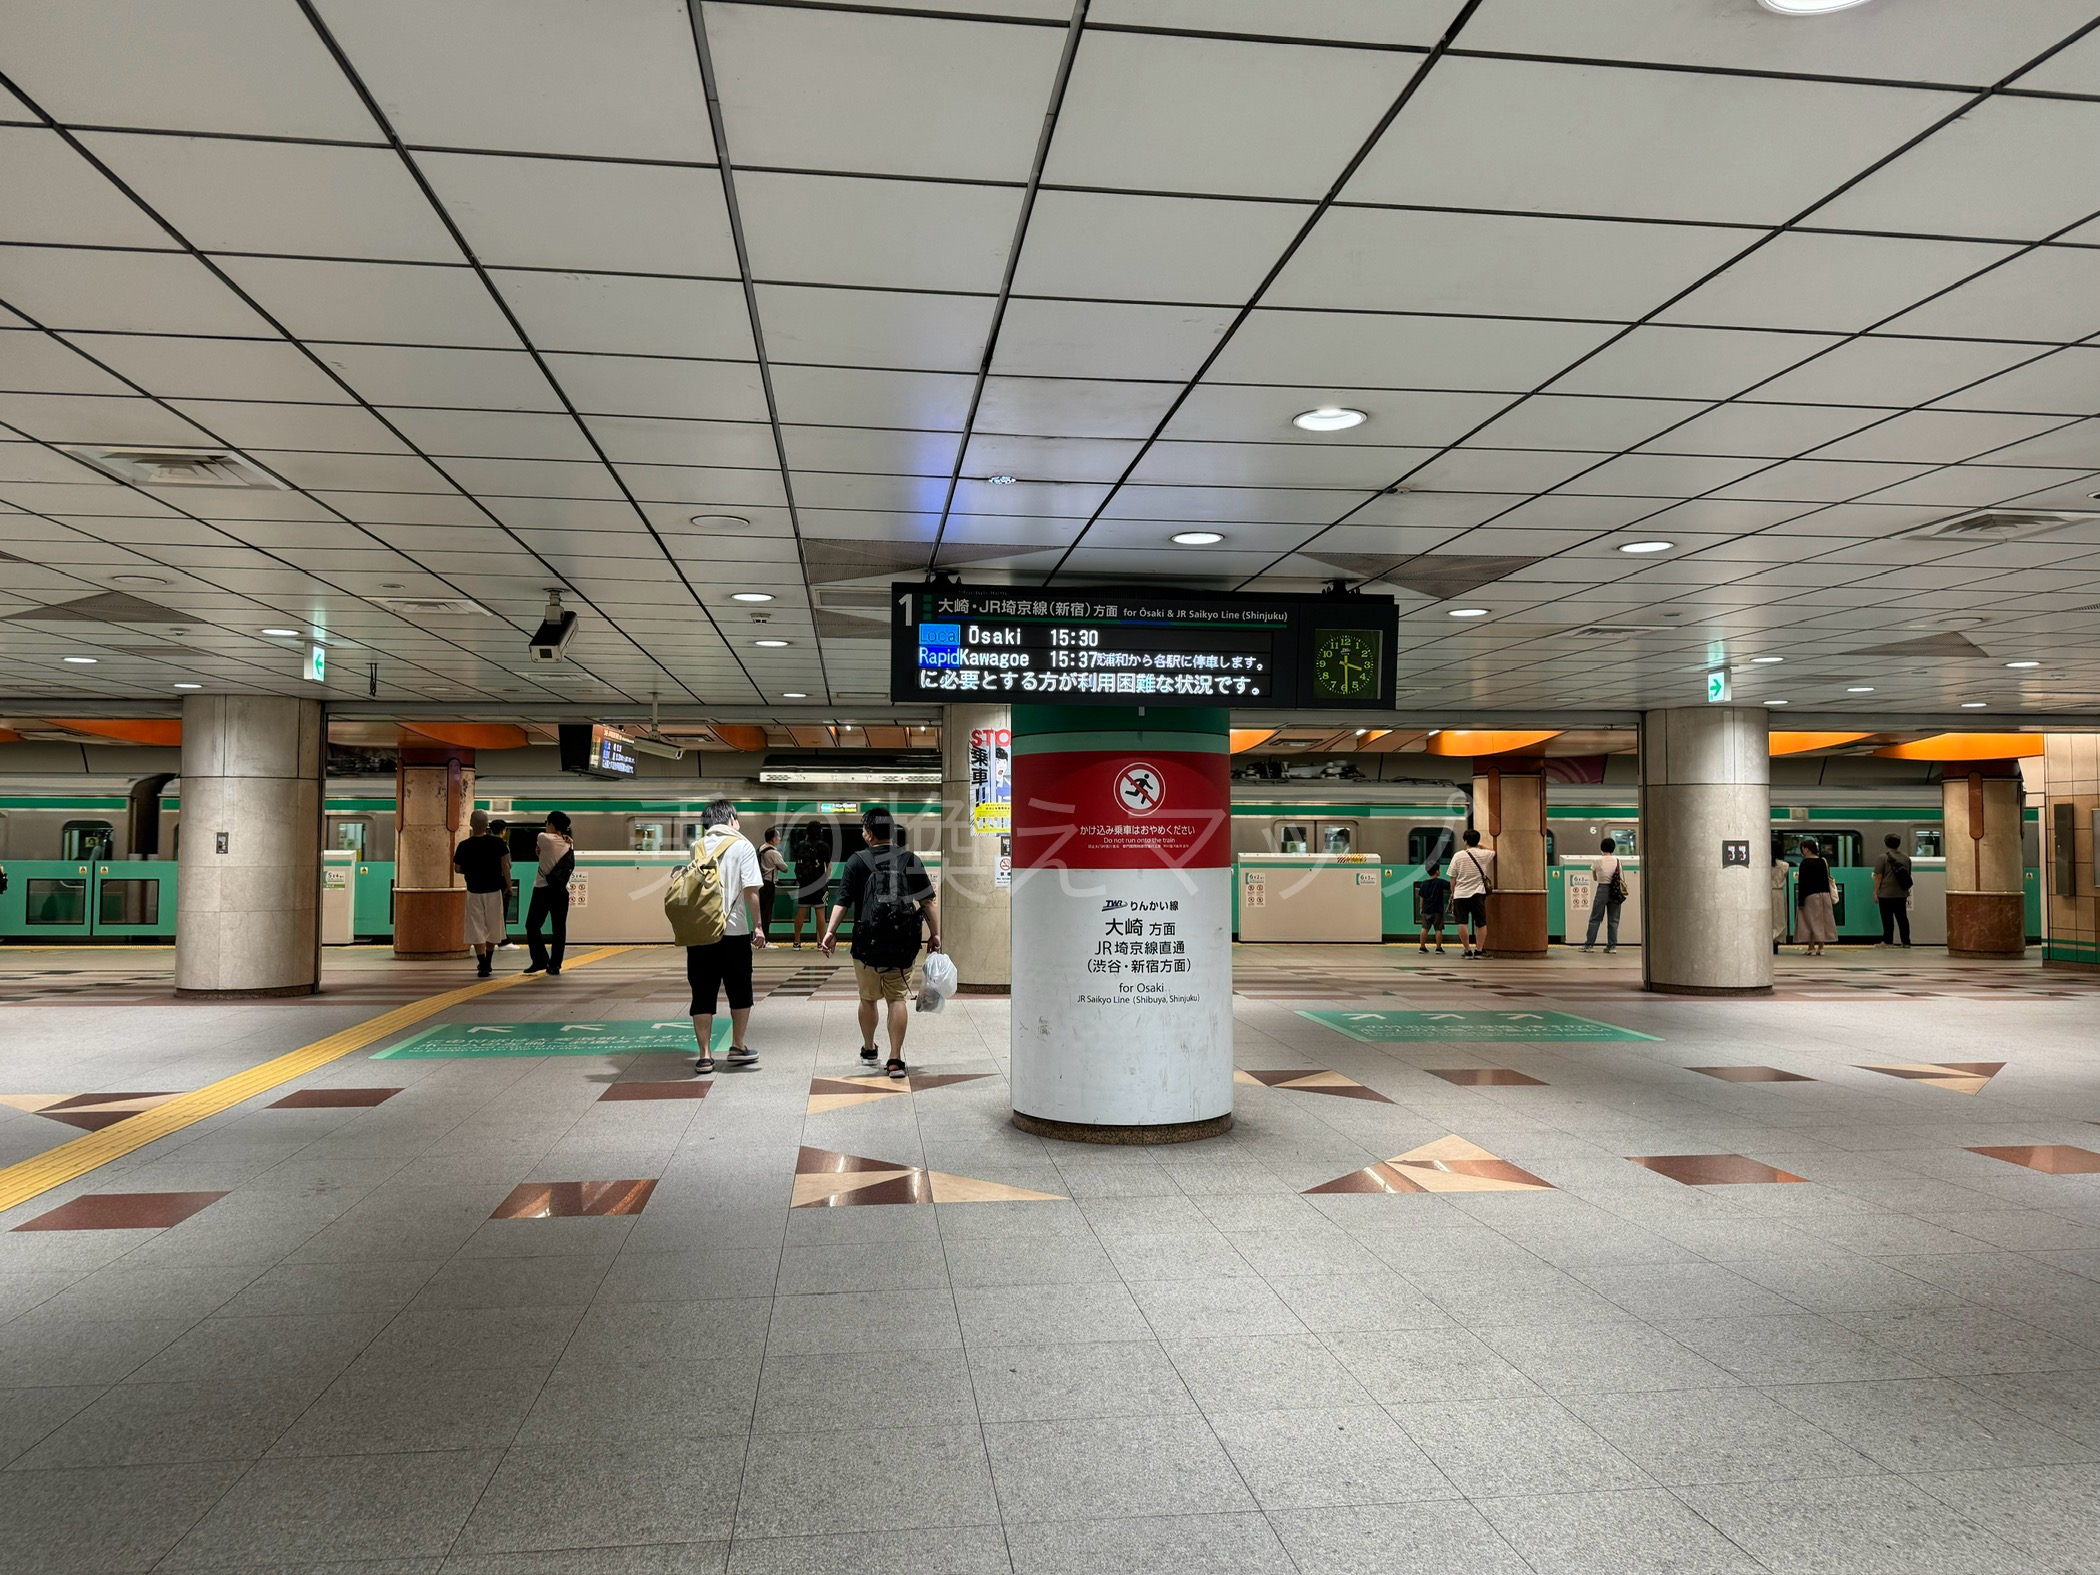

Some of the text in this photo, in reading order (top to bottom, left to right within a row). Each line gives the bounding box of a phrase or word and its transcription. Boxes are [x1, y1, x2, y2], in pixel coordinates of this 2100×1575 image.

[898, 593, 913, 627] 1
[1093, 605, 1118, 617] 方面
[1123, 608, 1137, 617] for
[1167, 609, 1174, 618] &
[1176, 609, 1187, 618] JR
[1189, 609, 1219, 620] Saikyo
[1221, 610, 1240, 619] Line
[1242, 611, 1288, 623] (Shinjuku)
[1050, 629, 1098, 647] 15:30
[1340, 638, 1351, 646] 12
[1356, 642, 1360, 650] 1
[919, 647, 960, 667] Rapid
[960, 648, 1029, 668] Kawagoe
[1050, 650, 1097, 668] 15:37
[1323, 650, 1332, 658] 10
[1361, 650, 1368, 658] 2
[1320, 660, 1326, 668] 9
[1322, 672, 1329, 680] 8
[1360, 672, 1366, 680] 4
[919, 670, 1260, 695] に必要とする方が利用困難な状況です。
[1330, 680, 1336, 688] 7
[1080, 825, 1195, 836] かけ込み乗車はおやめください
[1130, 900, 1179, 912] りんかい線
[1105, 918, 1176, 936] 大崎 方面
[1119, 983, 1164, 993] for Osaki
[1077, 995, 1086, 1003] JR
[1087, 995, 1112, 1005] Saikyo
[1113, 996, 1130, 1004] Line
[1169, 994, 1200, 1004] Shinjuku)
